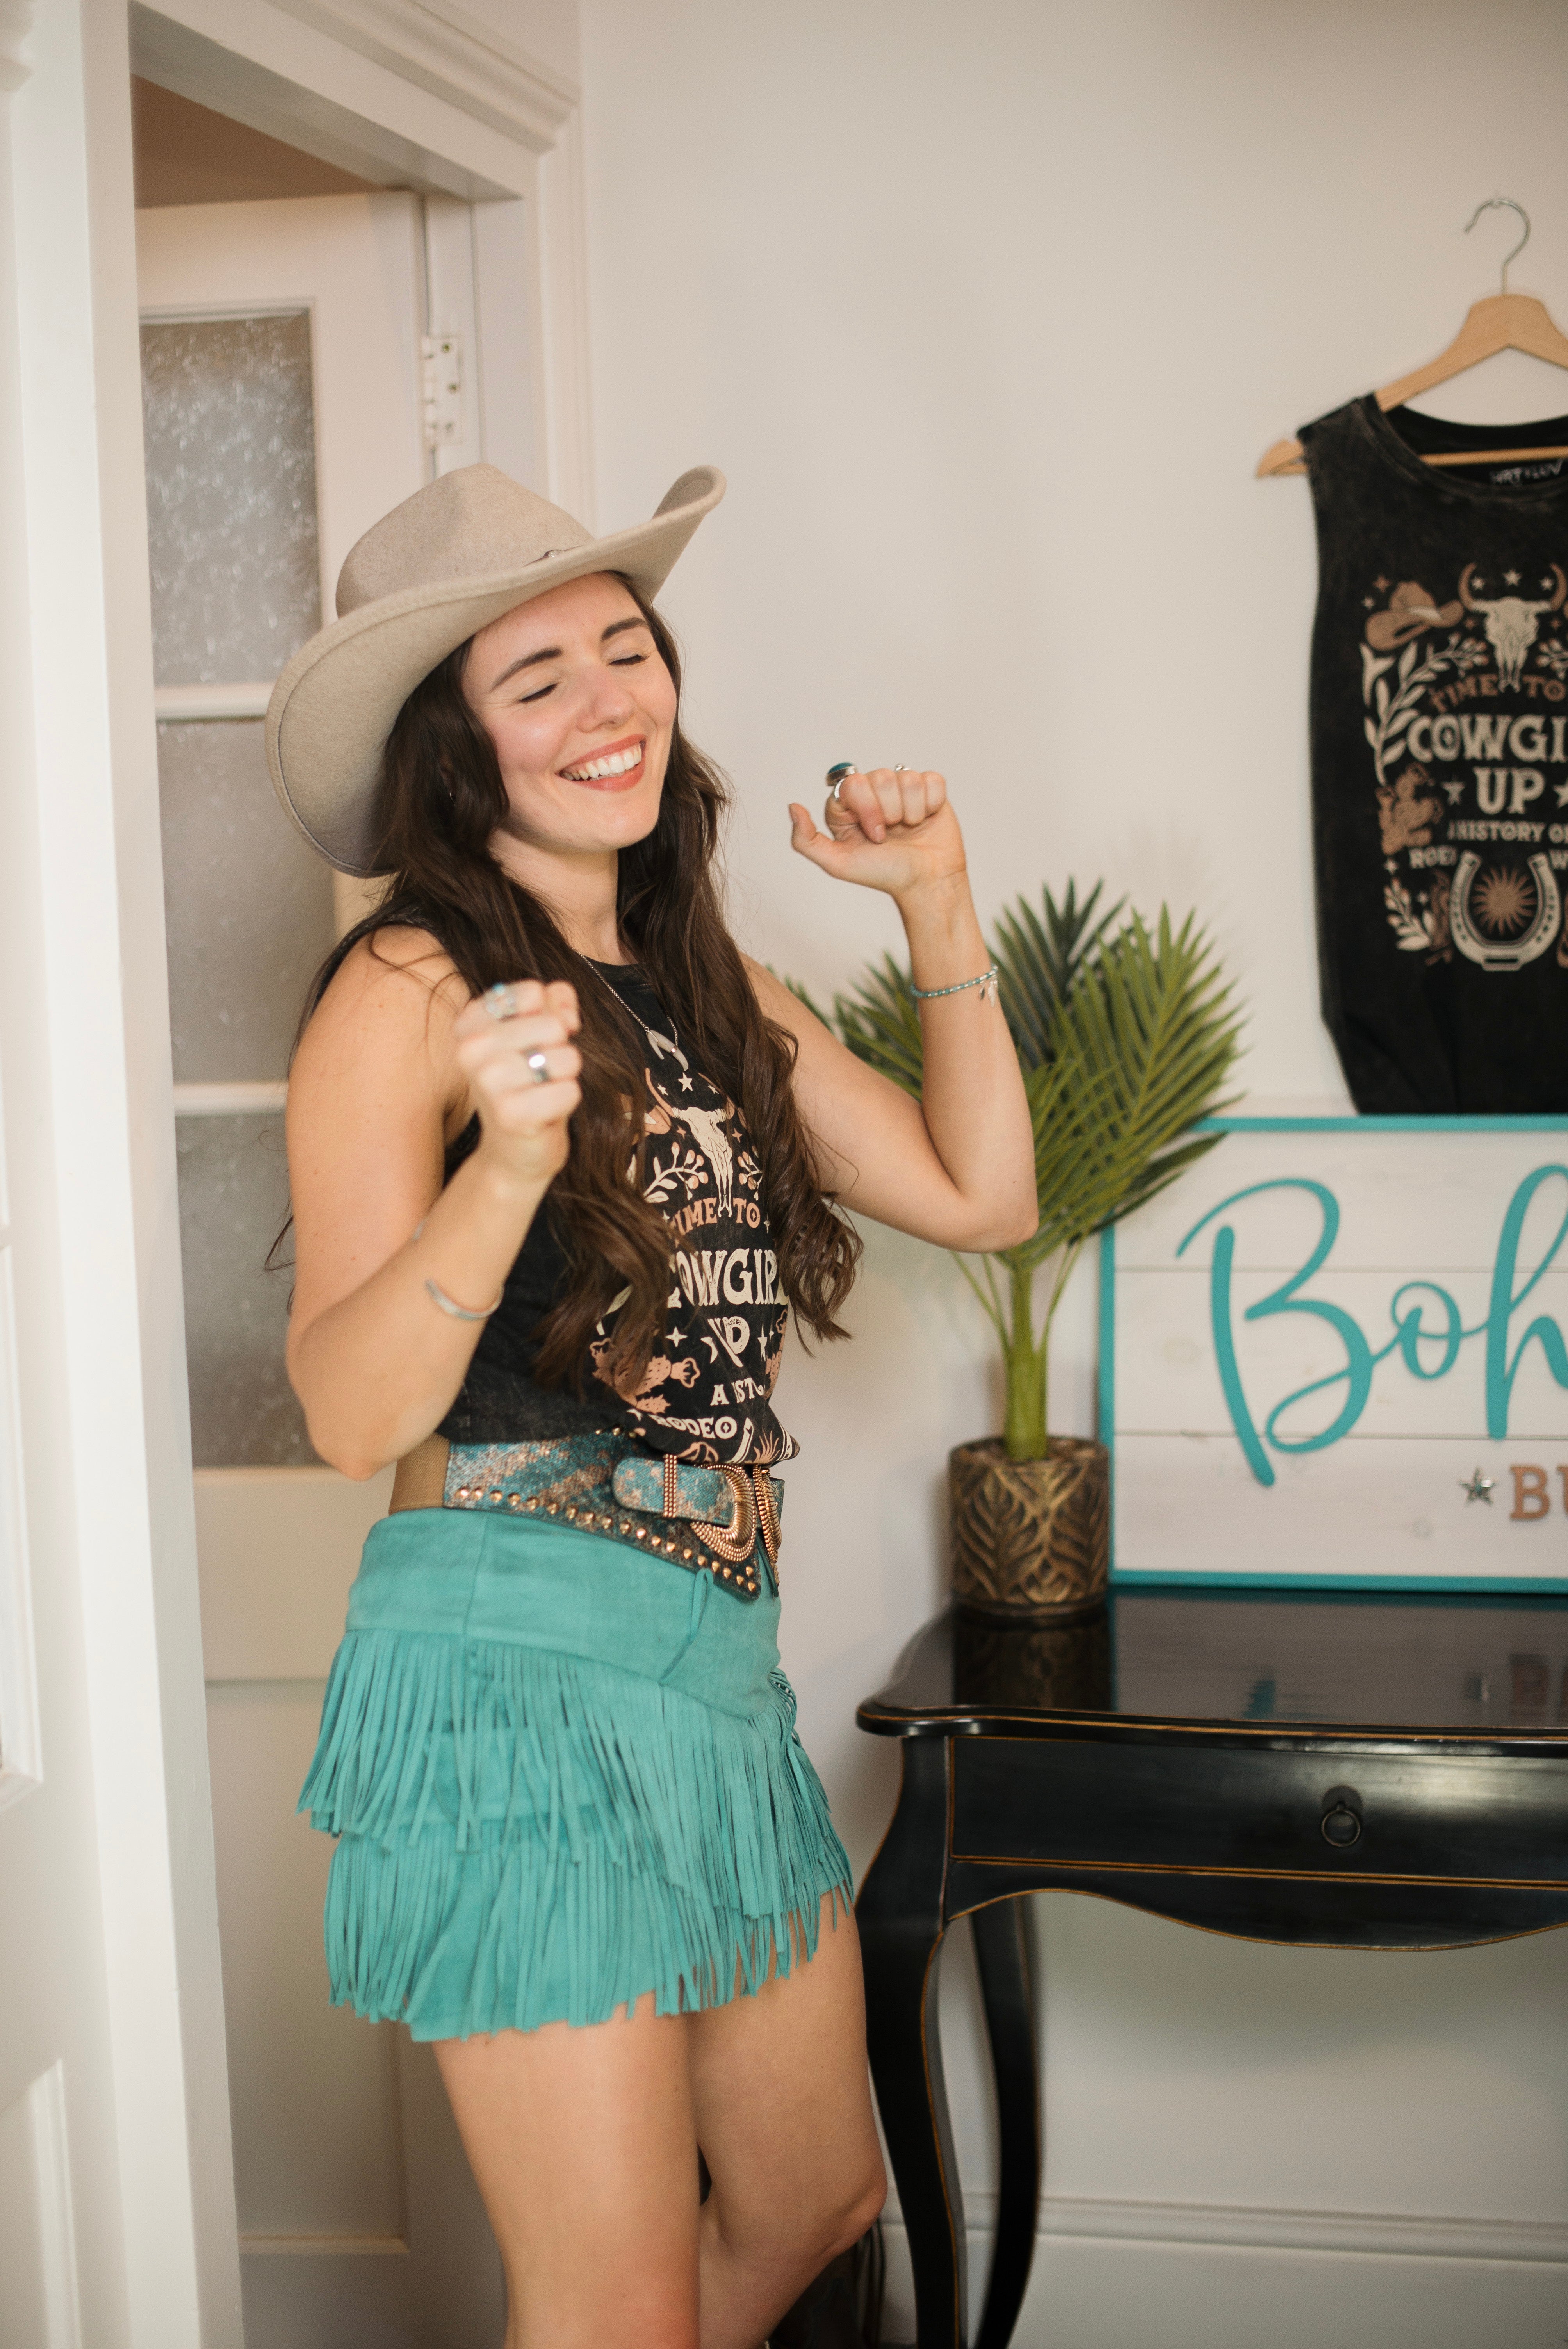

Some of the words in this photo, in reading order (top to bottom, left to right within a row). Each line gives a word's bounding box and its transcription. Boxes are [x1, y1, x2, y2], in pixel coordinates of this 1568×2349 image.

[1427, 674, 1499, 713] TIME
[1522, 675, 1566, 702] TO
[1473, 767, 1545, 815] UP
[733, 1198, 760, 1228] TO
[1175, 1163, 1568, 1488] Boh
[1509, 1465, 1568, 1521] B
